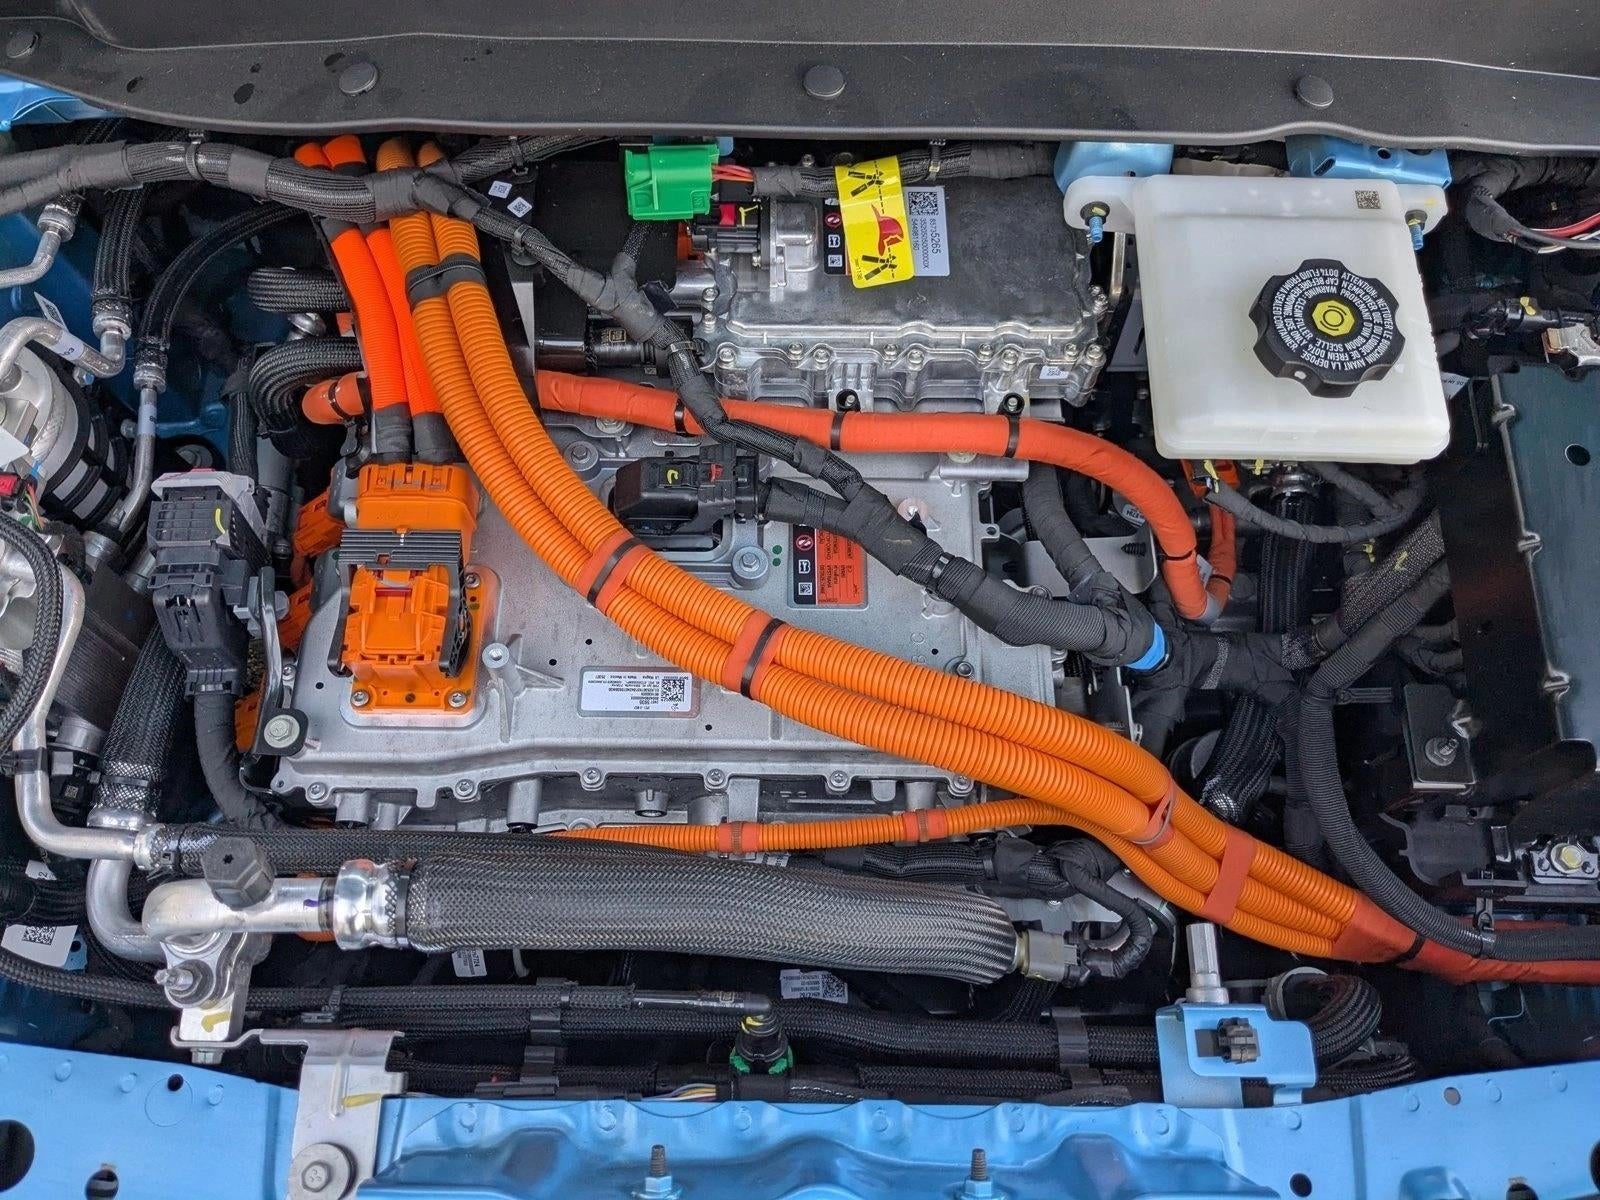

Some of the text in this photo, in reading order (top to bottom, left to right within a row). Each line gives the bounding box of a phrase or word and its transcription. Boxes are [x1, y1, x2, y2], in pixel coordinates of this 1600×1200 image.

[1299, 269, 1320, 280] FLUID
[1320, 269, 1339, 277] DOT4
[1282, 275, 1301, 290] FROM
[1298, 277, 1324, 291] BEFORE
[1325, 278, 1339, 286] CAP
[1273, 292, 1285, 315] SEALED
[1293, 297, 1306, 318] CLEAN
[1340, 289, 1372, 320] PROVENANT
[1284, 318, 1296, 331] USE
[1294, 318, 1313, 340] FILLER
[1290, 330, 1308, 346] ONLY
[1383, 330, 1393, 340] LE
[1345, 335, 1366, 351] BIDON
[1359, 335, 1380, 356] LIQUIDE
[1308, 344, 1325, 358] DOT4
[1327, 352, 1349, 361] FREIN
[1350, 350, 1361, 360] DE
[1365, 338, 1390, 365] BOUCHON
[1331, 361, 1341, 370] LA
[1344, 358, 1366, 370] AVANT
